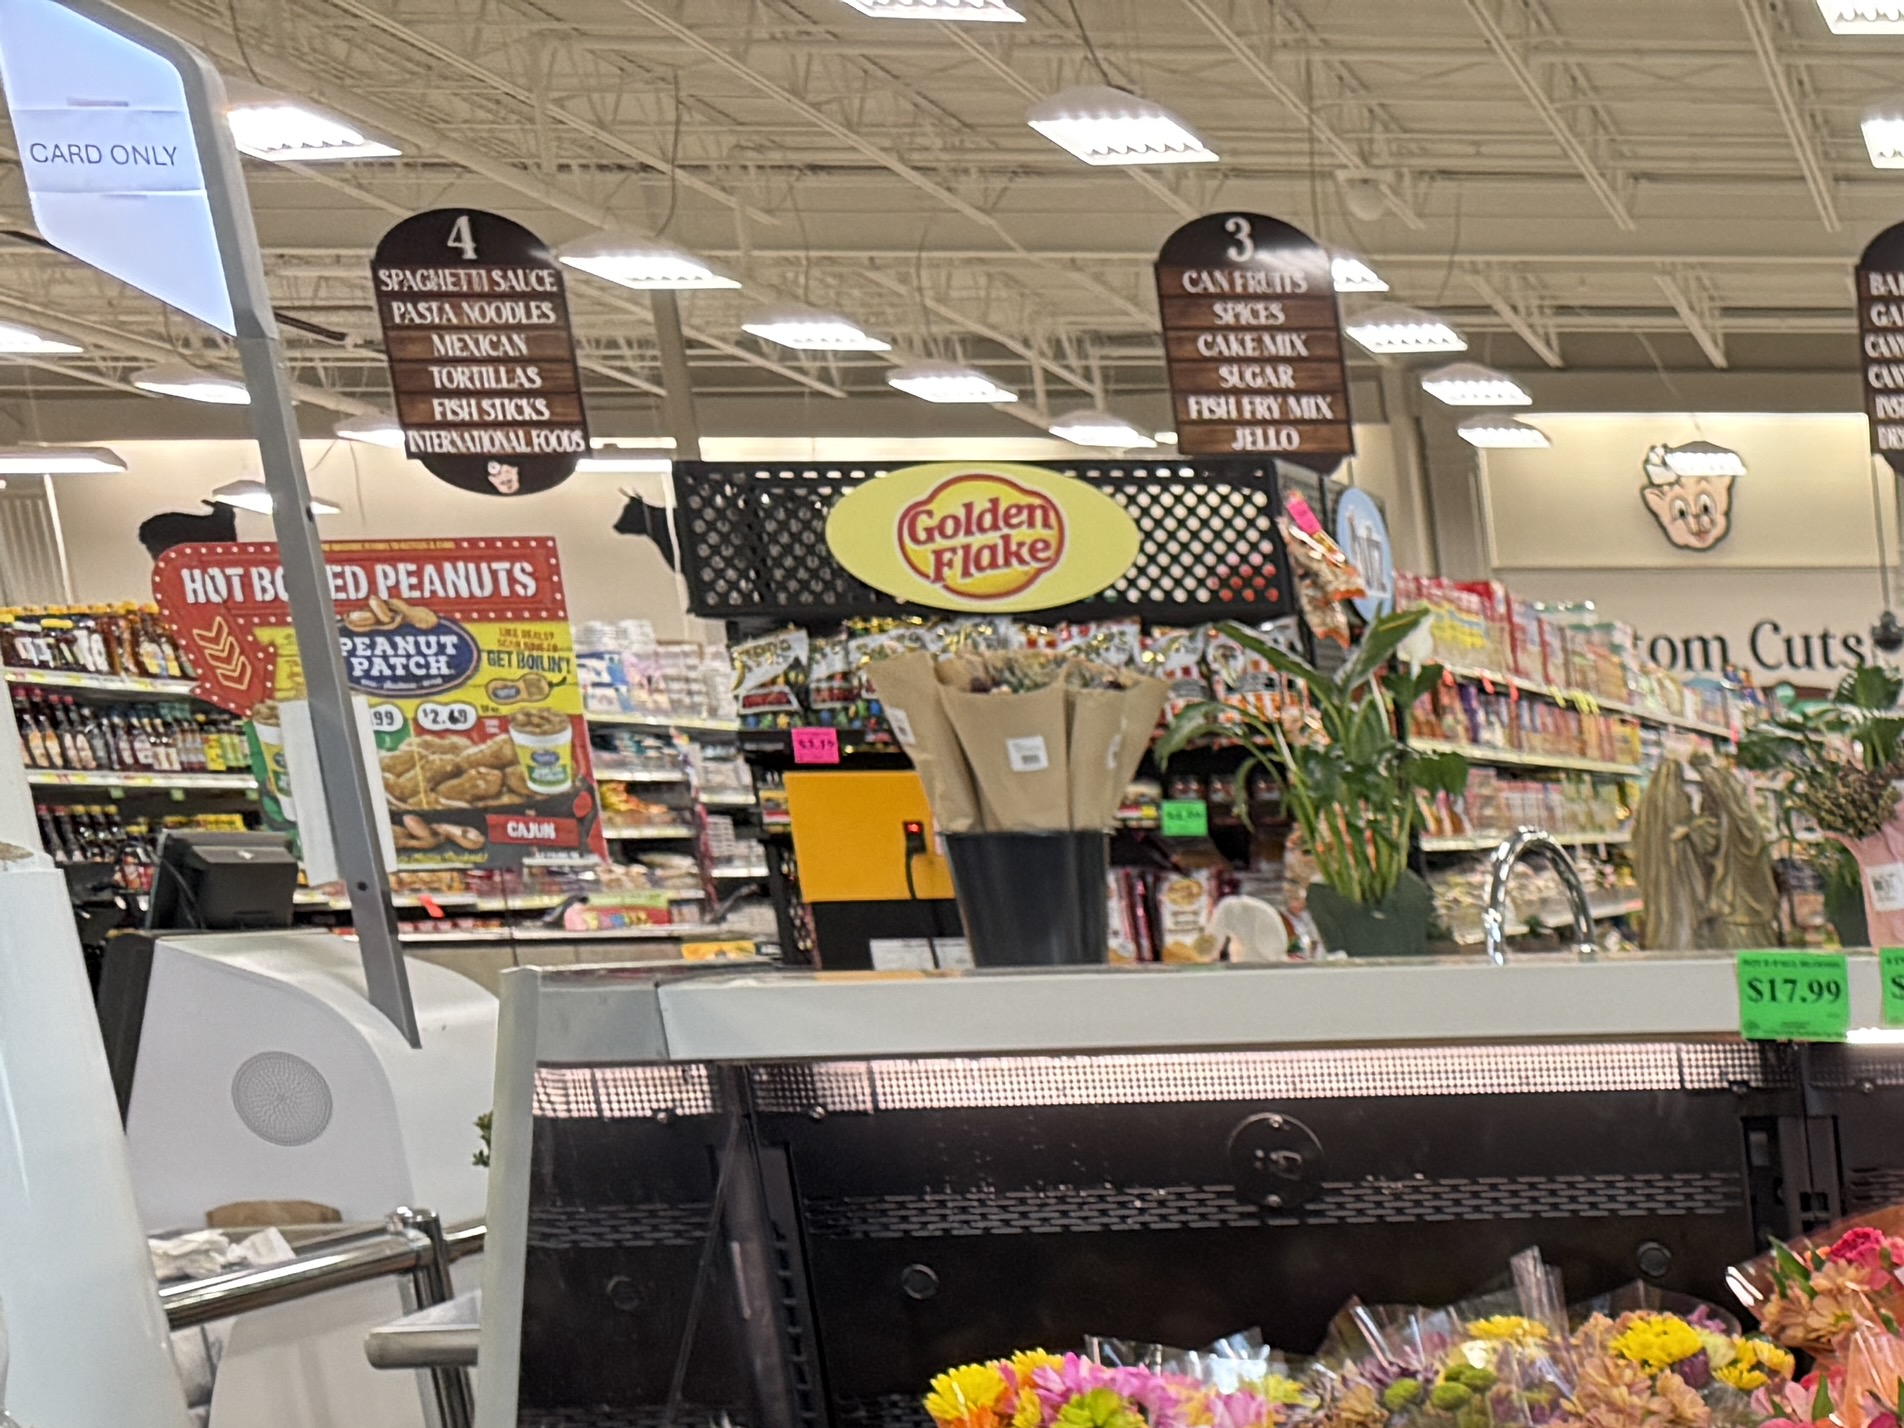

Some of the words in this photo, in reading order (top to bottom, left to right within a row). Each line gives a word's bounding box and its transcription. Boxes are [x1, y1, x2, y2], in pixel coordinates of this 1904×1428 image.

[30, 142, 102, 164] CARD
[110, 144, 177, 166] ONLY
[447, 215, 477, 260] 4
[1225, 217, 1254, 262] 3
[378, 269, 488, 291] SPAGHETTI
[492, 269, 557, 291] SAUCE
[1182, 270, 1229, 294] CAN
[1233, 271, 1308, 294] FRUITS
[392, 302, 456, 325] PASTA
[462, 302, 556, 324] NOODLES
[1213, 301, 1286, 325] SPICES
[431, 333, 528, 357] MEXICAN
[1197, 332, 1257, 357] CAKE
[1261, 333, 1309, 357] MIX
[429, 366, 542, 389] TORTILLAS
[1218, 364, 1296, 388] SUGAR
[433, 398, 477, 420] FISH
[484, 398, 549, 420] STICKS
[1187, 395, 1238, 419] FISH
[1243, 395, 1282, 419] FRY
[1286, 395, 1334, 419] MIX
[407, 430, 531, 453] INTERNATIONAL
[533, 429, 585, 451] FOODS
[1231, 426, 1300, 451] JELLO
[907, 497, 1054, 546] Golden
[930, 533, 1051, 583] Flake
[180, 567, 244, 604] HOT
[252, 563, 369, 602] BOED
[374, 560, 538, 599] PEANUTS
[1750, 620, 1866, 671] Cuts
[350, 655, 452, 677] PATCH
[487, 650, 513, 668] GET
[506, 821, 556, 840] CAJUN
[1747, 976, 1842, 1004] $17.99
